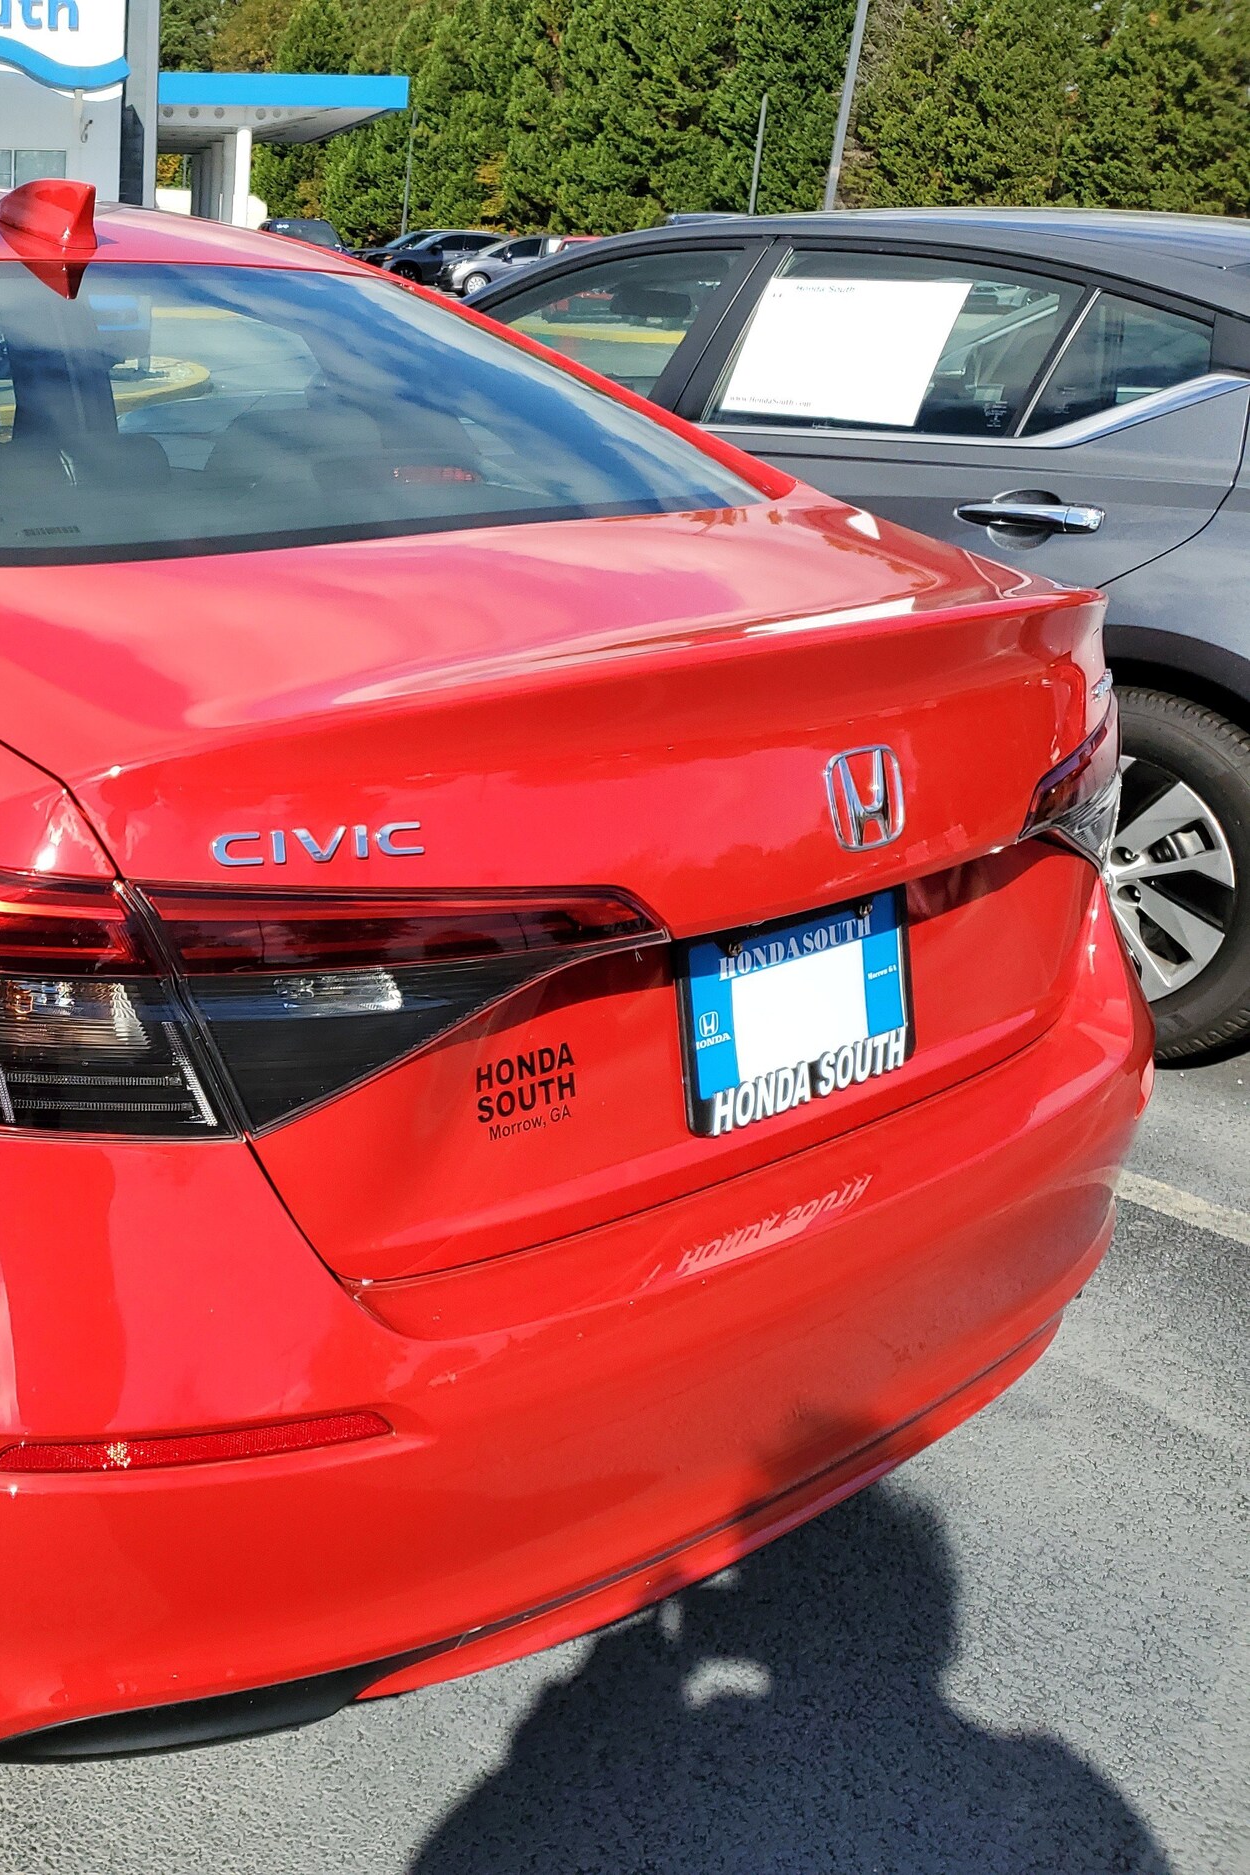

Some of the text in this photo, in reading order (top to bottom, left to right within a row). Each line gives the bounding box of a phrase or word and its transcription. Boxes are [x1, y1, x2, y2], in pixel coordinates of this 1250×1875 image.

[211, 821, 425, 867] CIVIC
[719, 914, 872, 981] HONDA SOUTH
[476, 1042, 575, 1093] HONDA
[712, 1027, 905, 1137] HONDA SOUTH
[477, 1072, 576, 1123] SOUTH
[489, 1104, 572, 1141] Morrow, GA
